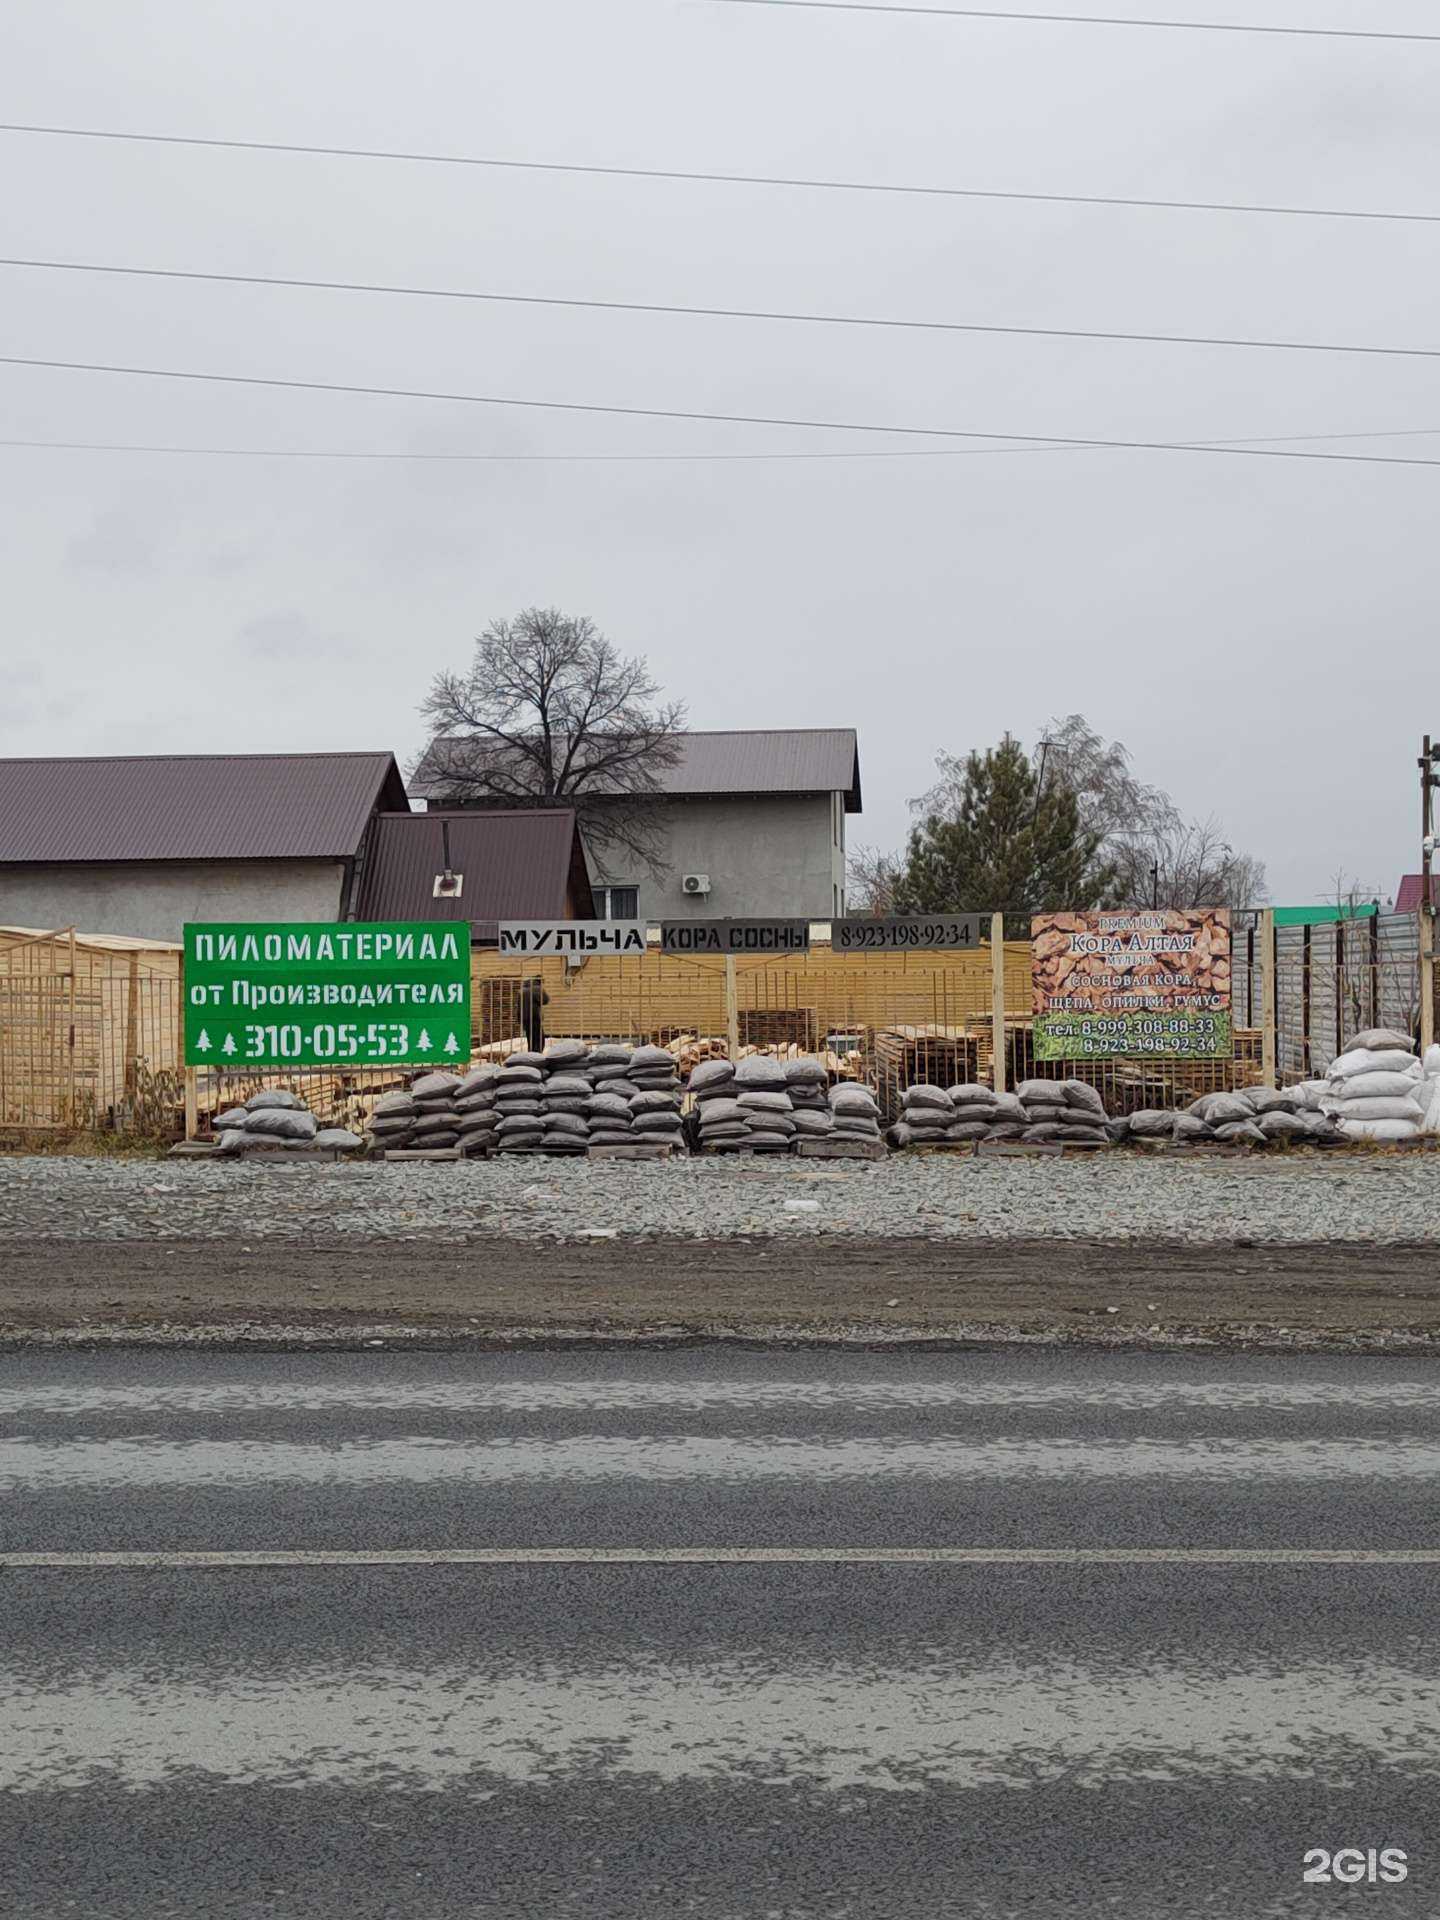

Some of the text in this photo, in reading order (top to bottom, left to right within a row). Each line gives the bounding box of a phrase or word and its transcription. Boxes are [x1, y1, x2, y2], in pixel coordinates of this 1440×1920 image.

[1099, 917, 1165, 929] PREMIUM
[500, 928, 644, 951] МУЛЬЧА
[663, 927, 808, 948] КОРА СОСНЫ
[195, 933, 459, 961] ПИЛОМАТЕРИАЛ
[1071, 975, 1149, 987] СОСНОВАЯ
[191, 980, 463, 1010] от Производителя
[1046, 1020, 1214, 1036] тел. 8-999-308-88-33
[1083, 1037, 1216, 1052] 8-923-198-92-34
